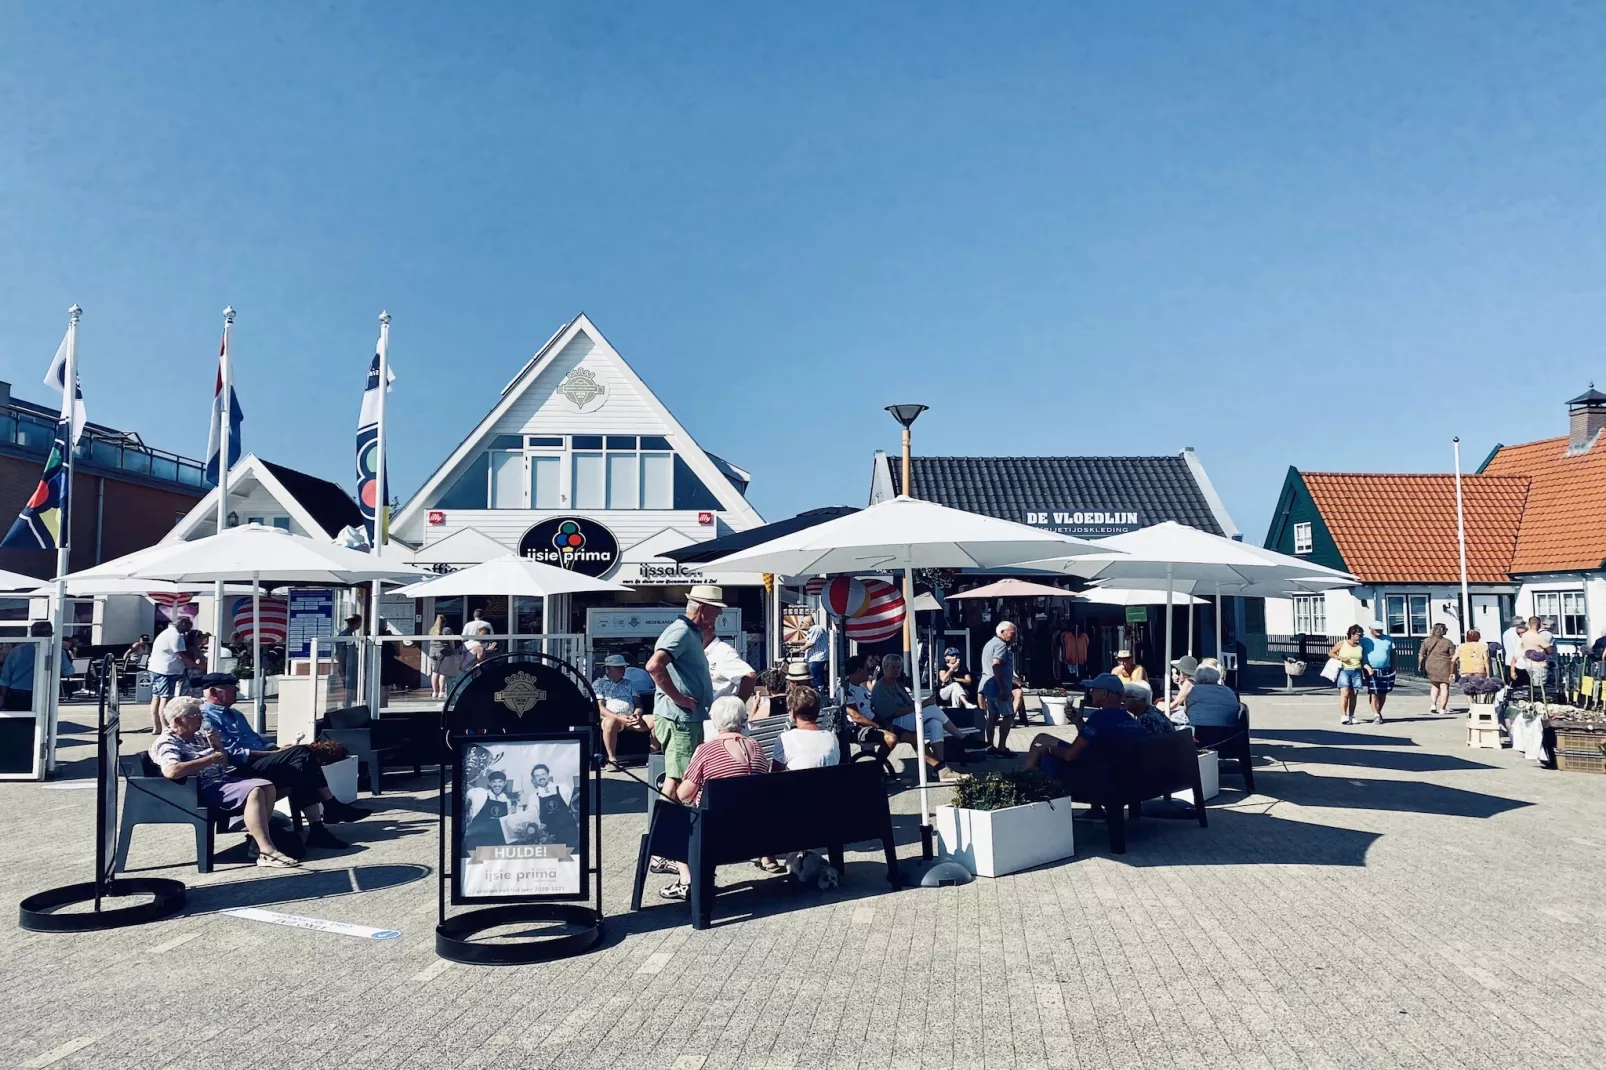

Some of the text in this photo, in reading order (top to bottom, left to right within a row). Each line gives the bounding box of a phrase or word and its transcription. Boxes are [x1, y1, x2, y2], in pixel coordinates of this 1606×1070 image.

[430, 513, 442, 522] illy
[699, 513, 711, 523] illy
[1026, 512, 1138, 524] DE VLOEDLIJN
[527, 548, 611, 564] ijsie prima
[494, 846, 547, 858] HULDE!
[485, 868, 557, 882] ijsie prima
